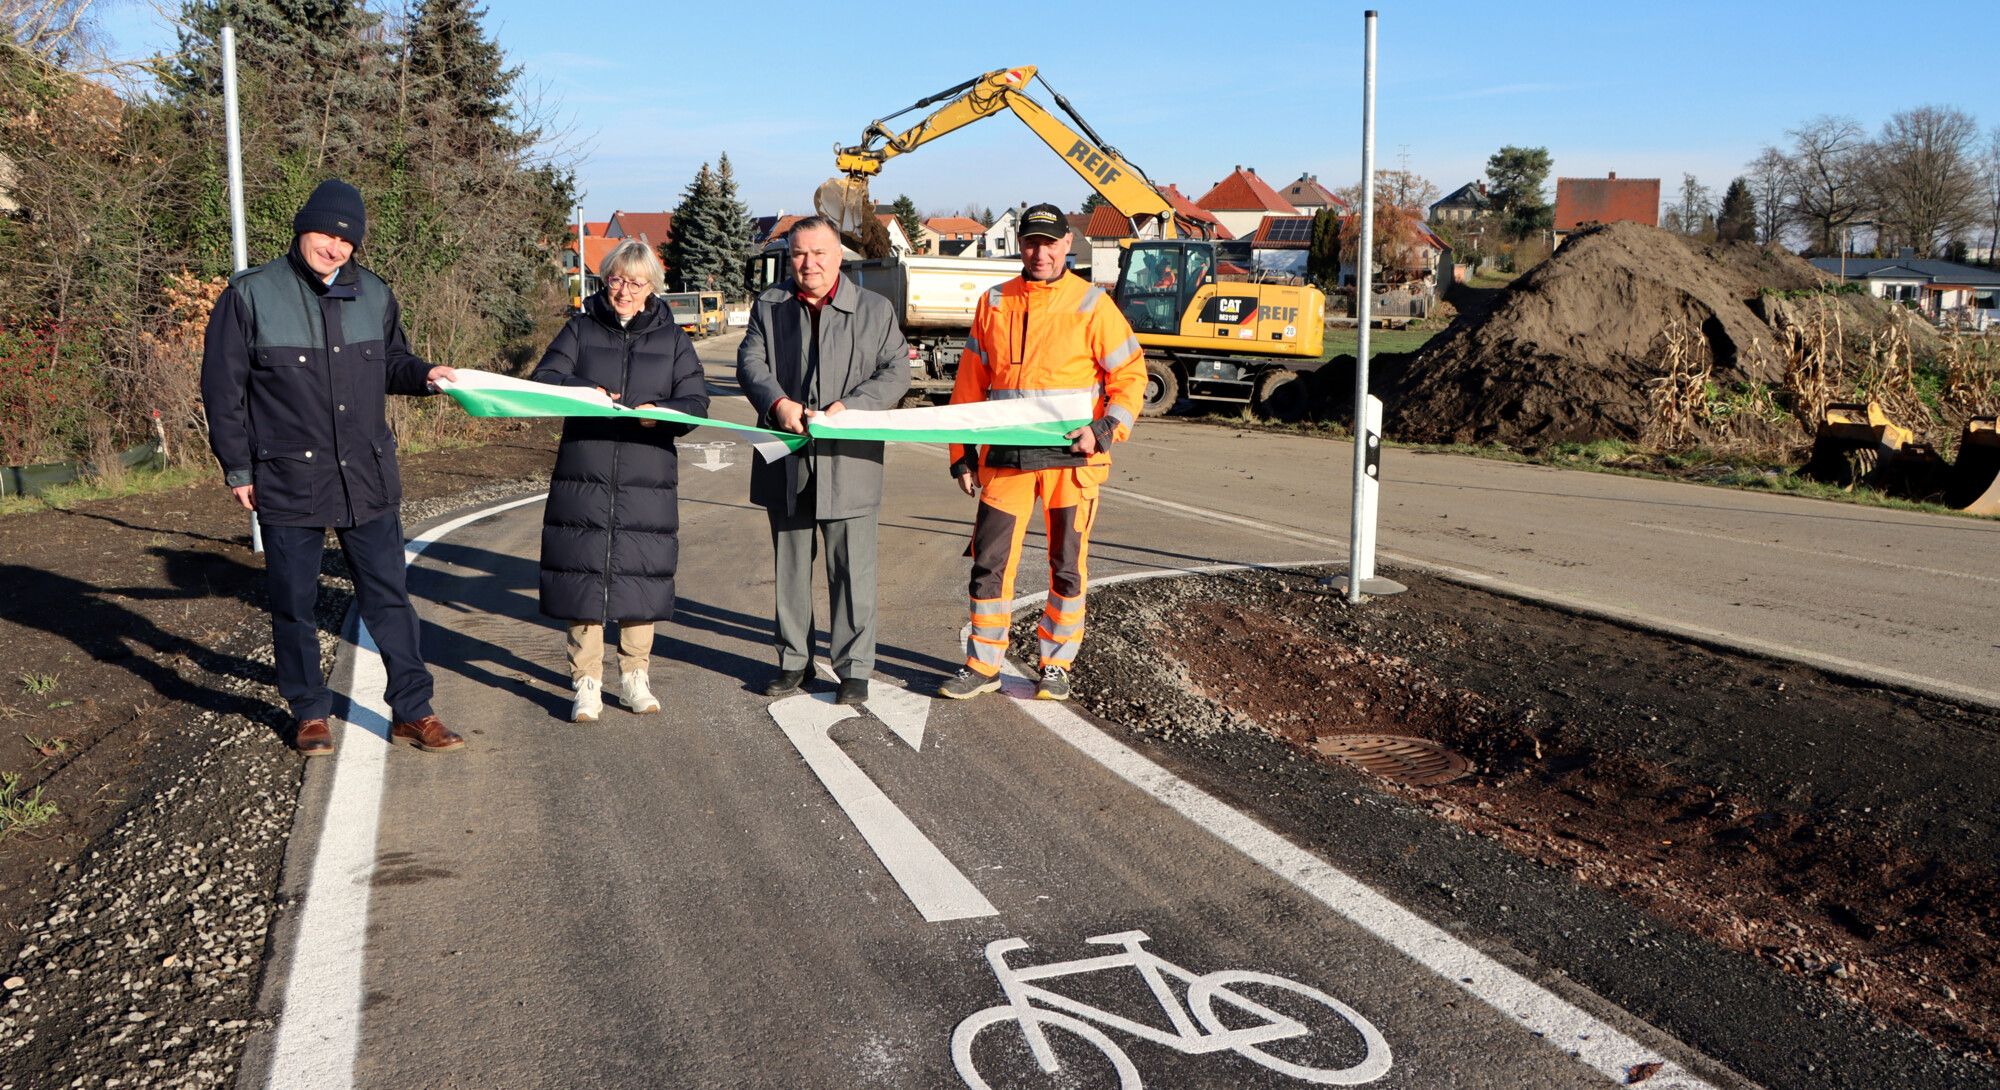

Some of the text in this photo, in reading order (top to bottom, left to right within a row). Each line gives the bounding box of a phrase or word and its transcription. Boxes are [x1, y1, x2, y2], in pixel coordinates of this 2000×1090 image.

[1065, 139, 1122, 185] REIF
[1219, 298, 1242, 313] CAT
[1259, 305, 1299, 324] REIF
[1286, 327, 1295, 336] 20
